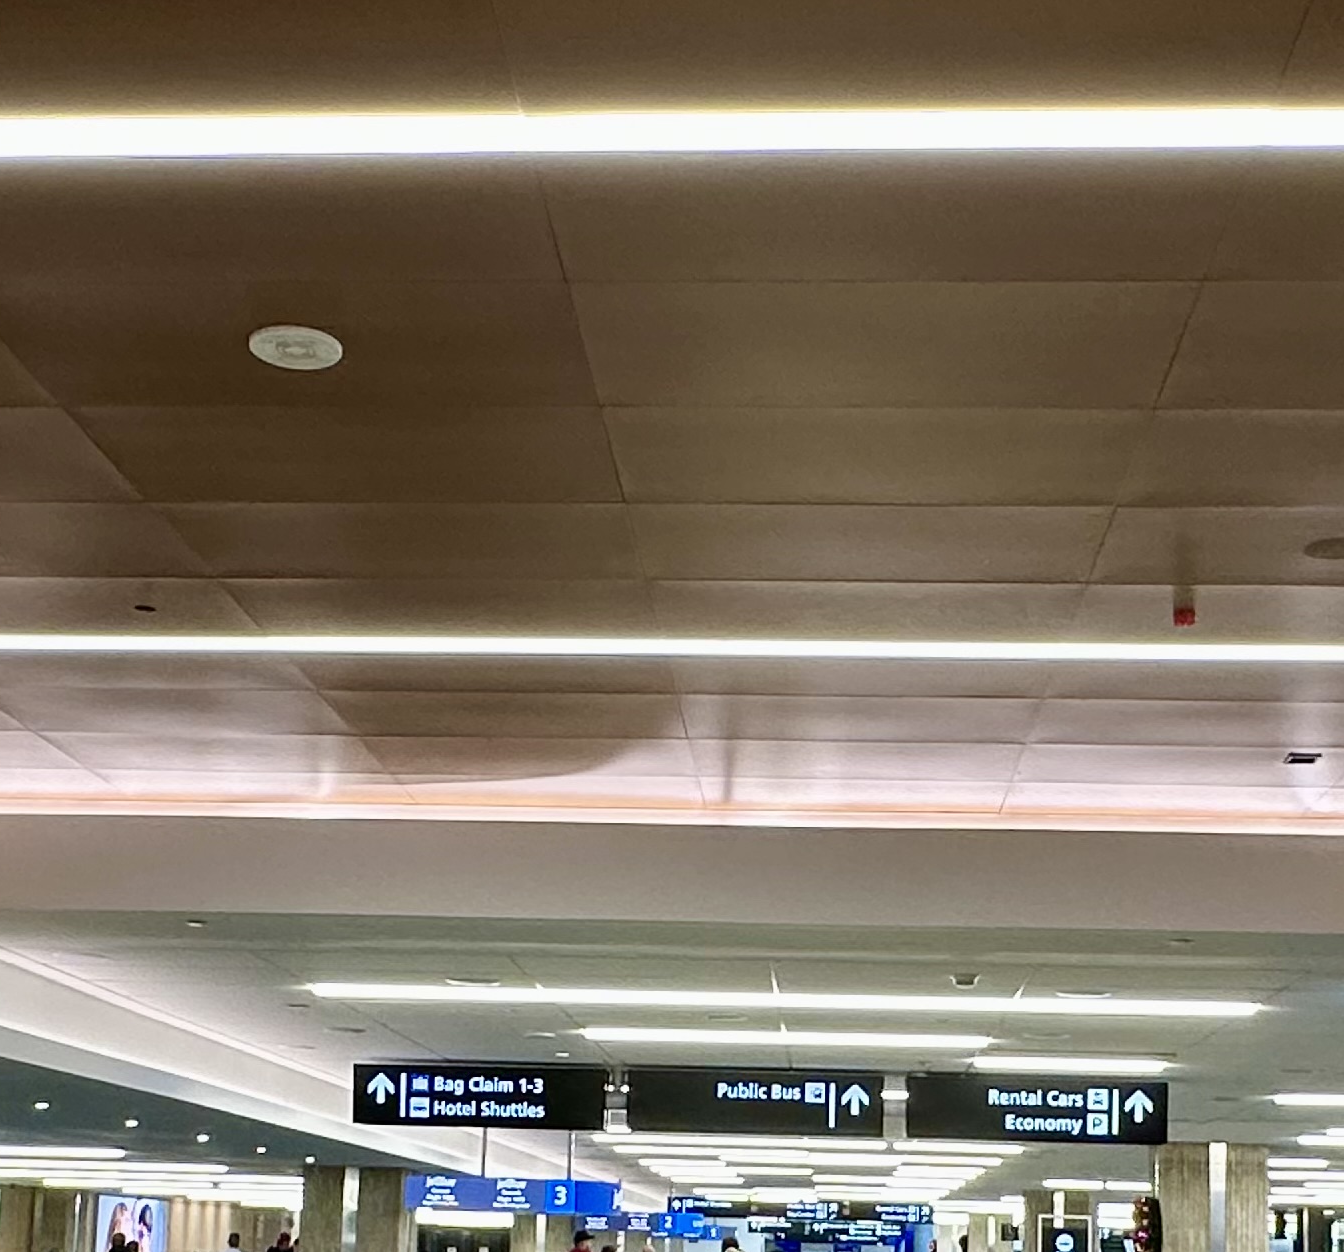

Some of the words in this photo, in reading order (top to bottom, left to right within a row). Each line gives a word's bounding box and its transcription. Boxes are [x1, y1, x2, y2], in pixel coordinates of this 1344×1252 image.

[433, 1075, 465, 1096] Bag
[468, 1075, 514, 1093] Claim
[518, 1077, 545, 1094] 1-3
[716, 1082, 768, 1100] Public
[770, 1083, 802, 1100] Bus
[987, 1088, 1043, 1106] Rental
[1046, 1090, 1085, 1108] Cars
[433, 1100, 476, 1117] Hotel
[480, 1101, 546, 1118] Shuttles
[1004, 1114, 1084, 1136] Economy
[553, 1185, 568, 1206] 3
[664, 1215, 673, 1229] 2
